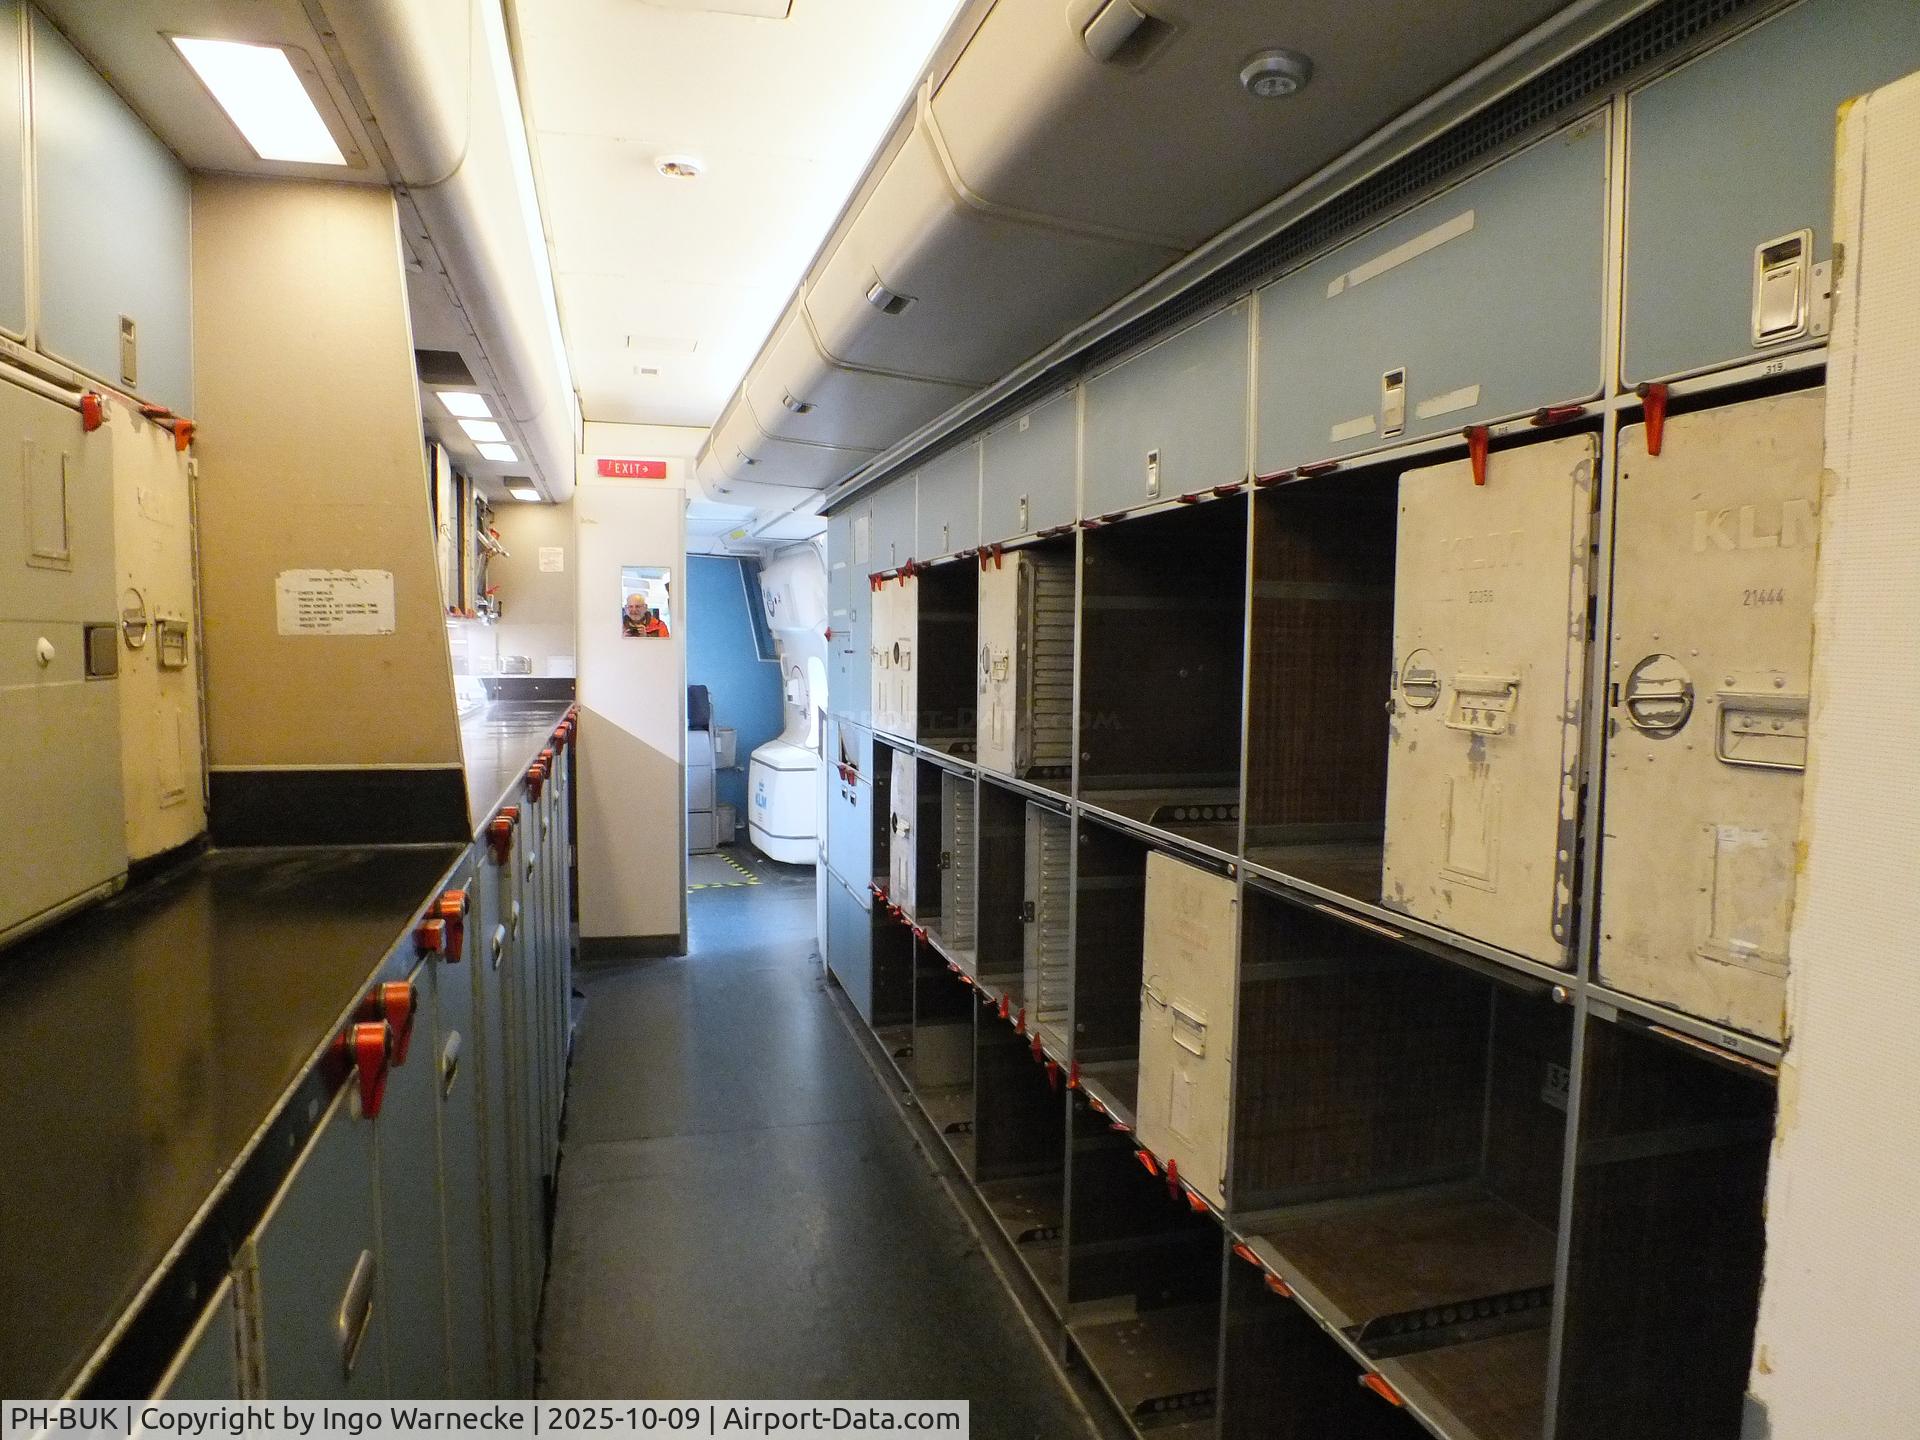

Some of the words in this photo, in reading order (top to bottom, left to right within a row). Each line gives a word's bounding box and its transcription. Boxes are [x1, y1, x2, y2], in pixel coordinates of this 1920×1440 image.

[1766, 362, 1784, 375] 319
[615, 463, 640, 475] EXIT
[1743, 589, 1785, 606] 21444
